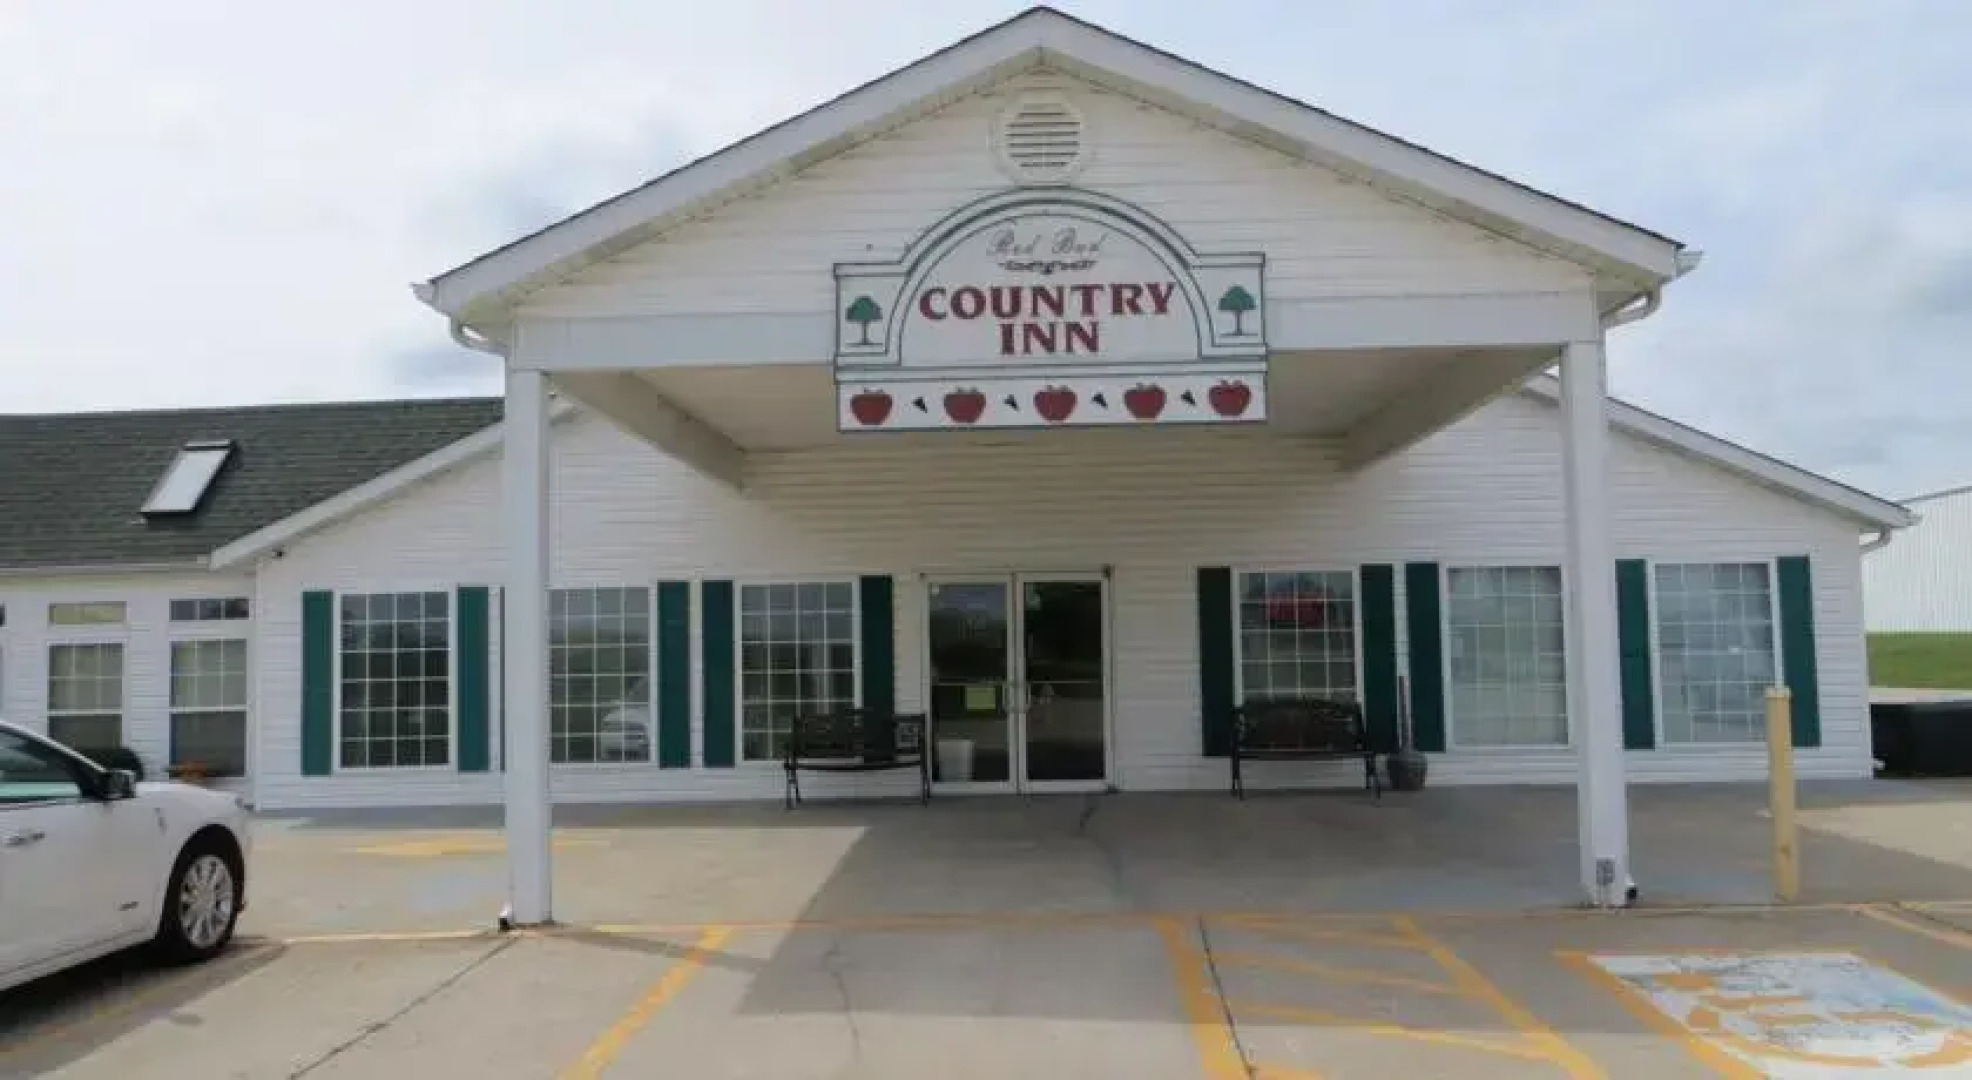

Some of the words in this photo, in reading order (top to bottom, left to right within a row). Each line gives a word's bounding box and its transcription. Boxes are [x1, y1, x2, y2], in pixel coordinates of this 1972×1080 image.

[986, 228, 1041, 257] Red
[919, 282, 1175, 320] COUNTRY
[1000, 321, 1100, 355] INN
